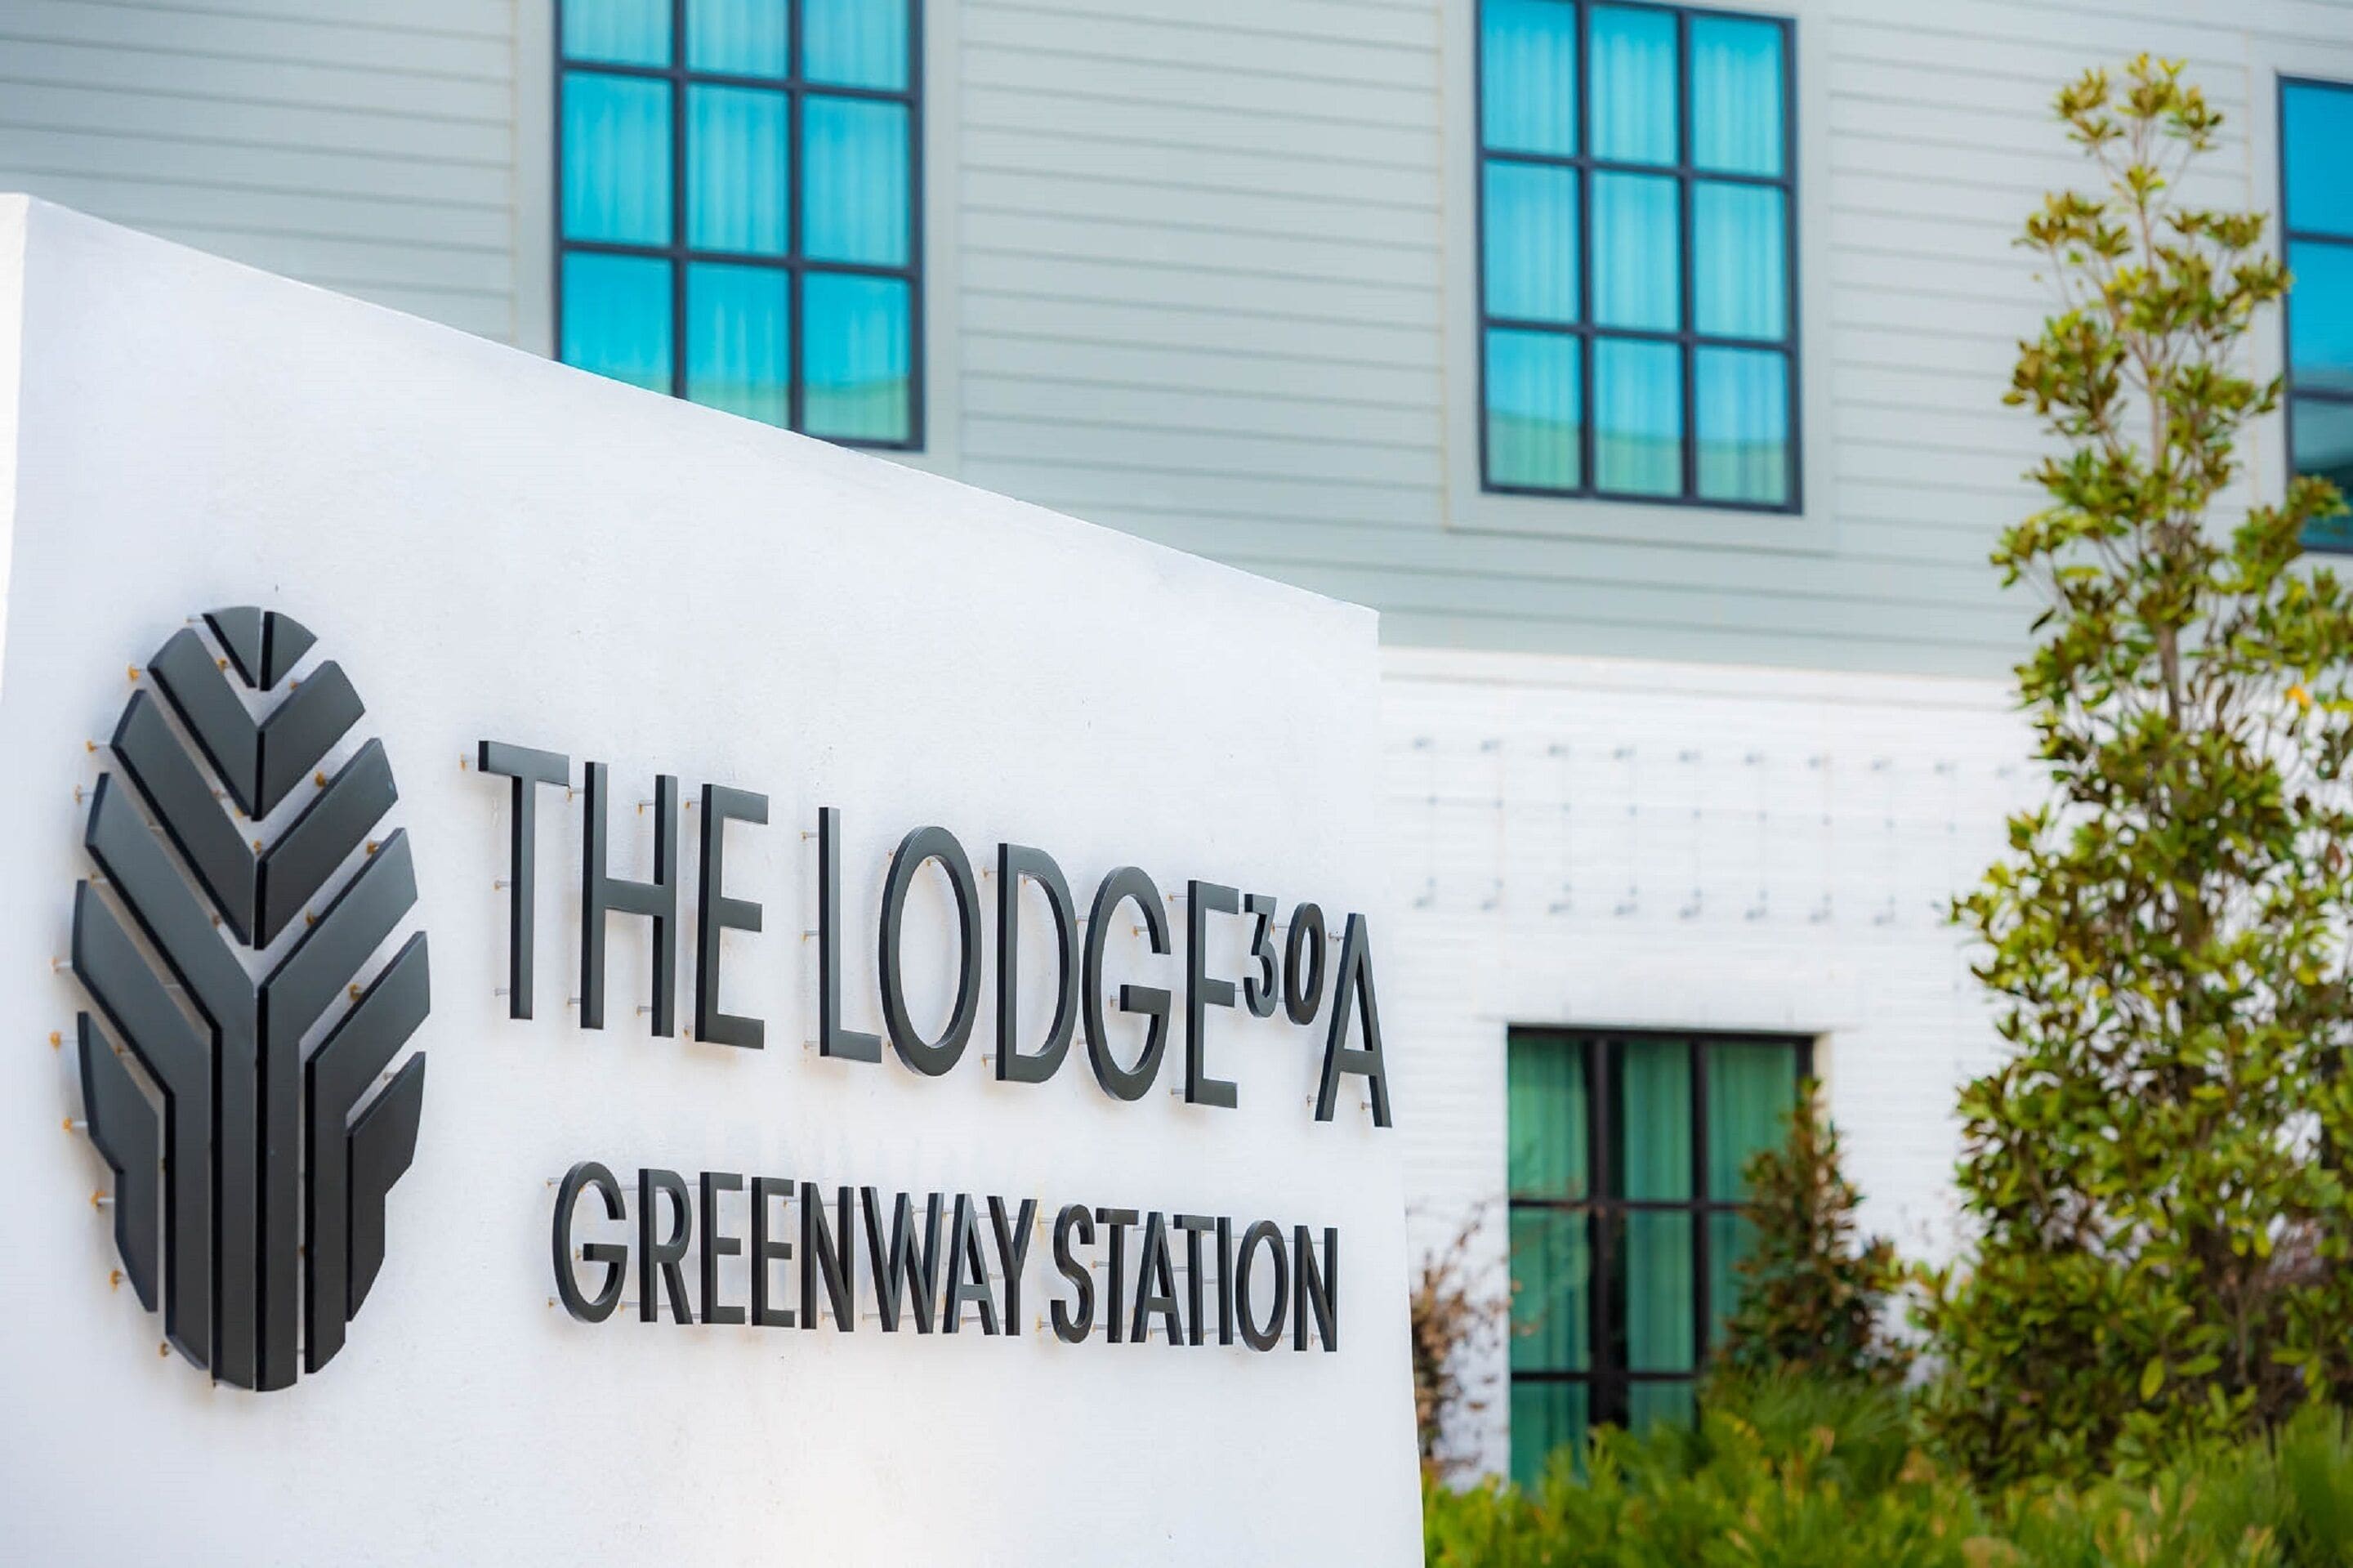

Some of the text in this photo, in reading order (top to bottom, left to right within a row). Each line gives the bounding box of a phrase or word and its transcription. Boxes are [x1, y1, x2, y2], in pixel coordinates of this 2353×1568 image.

[478, 740, 769, 1050] THE
[552, 1162, 1338, 1353] GREENWAY STATION
